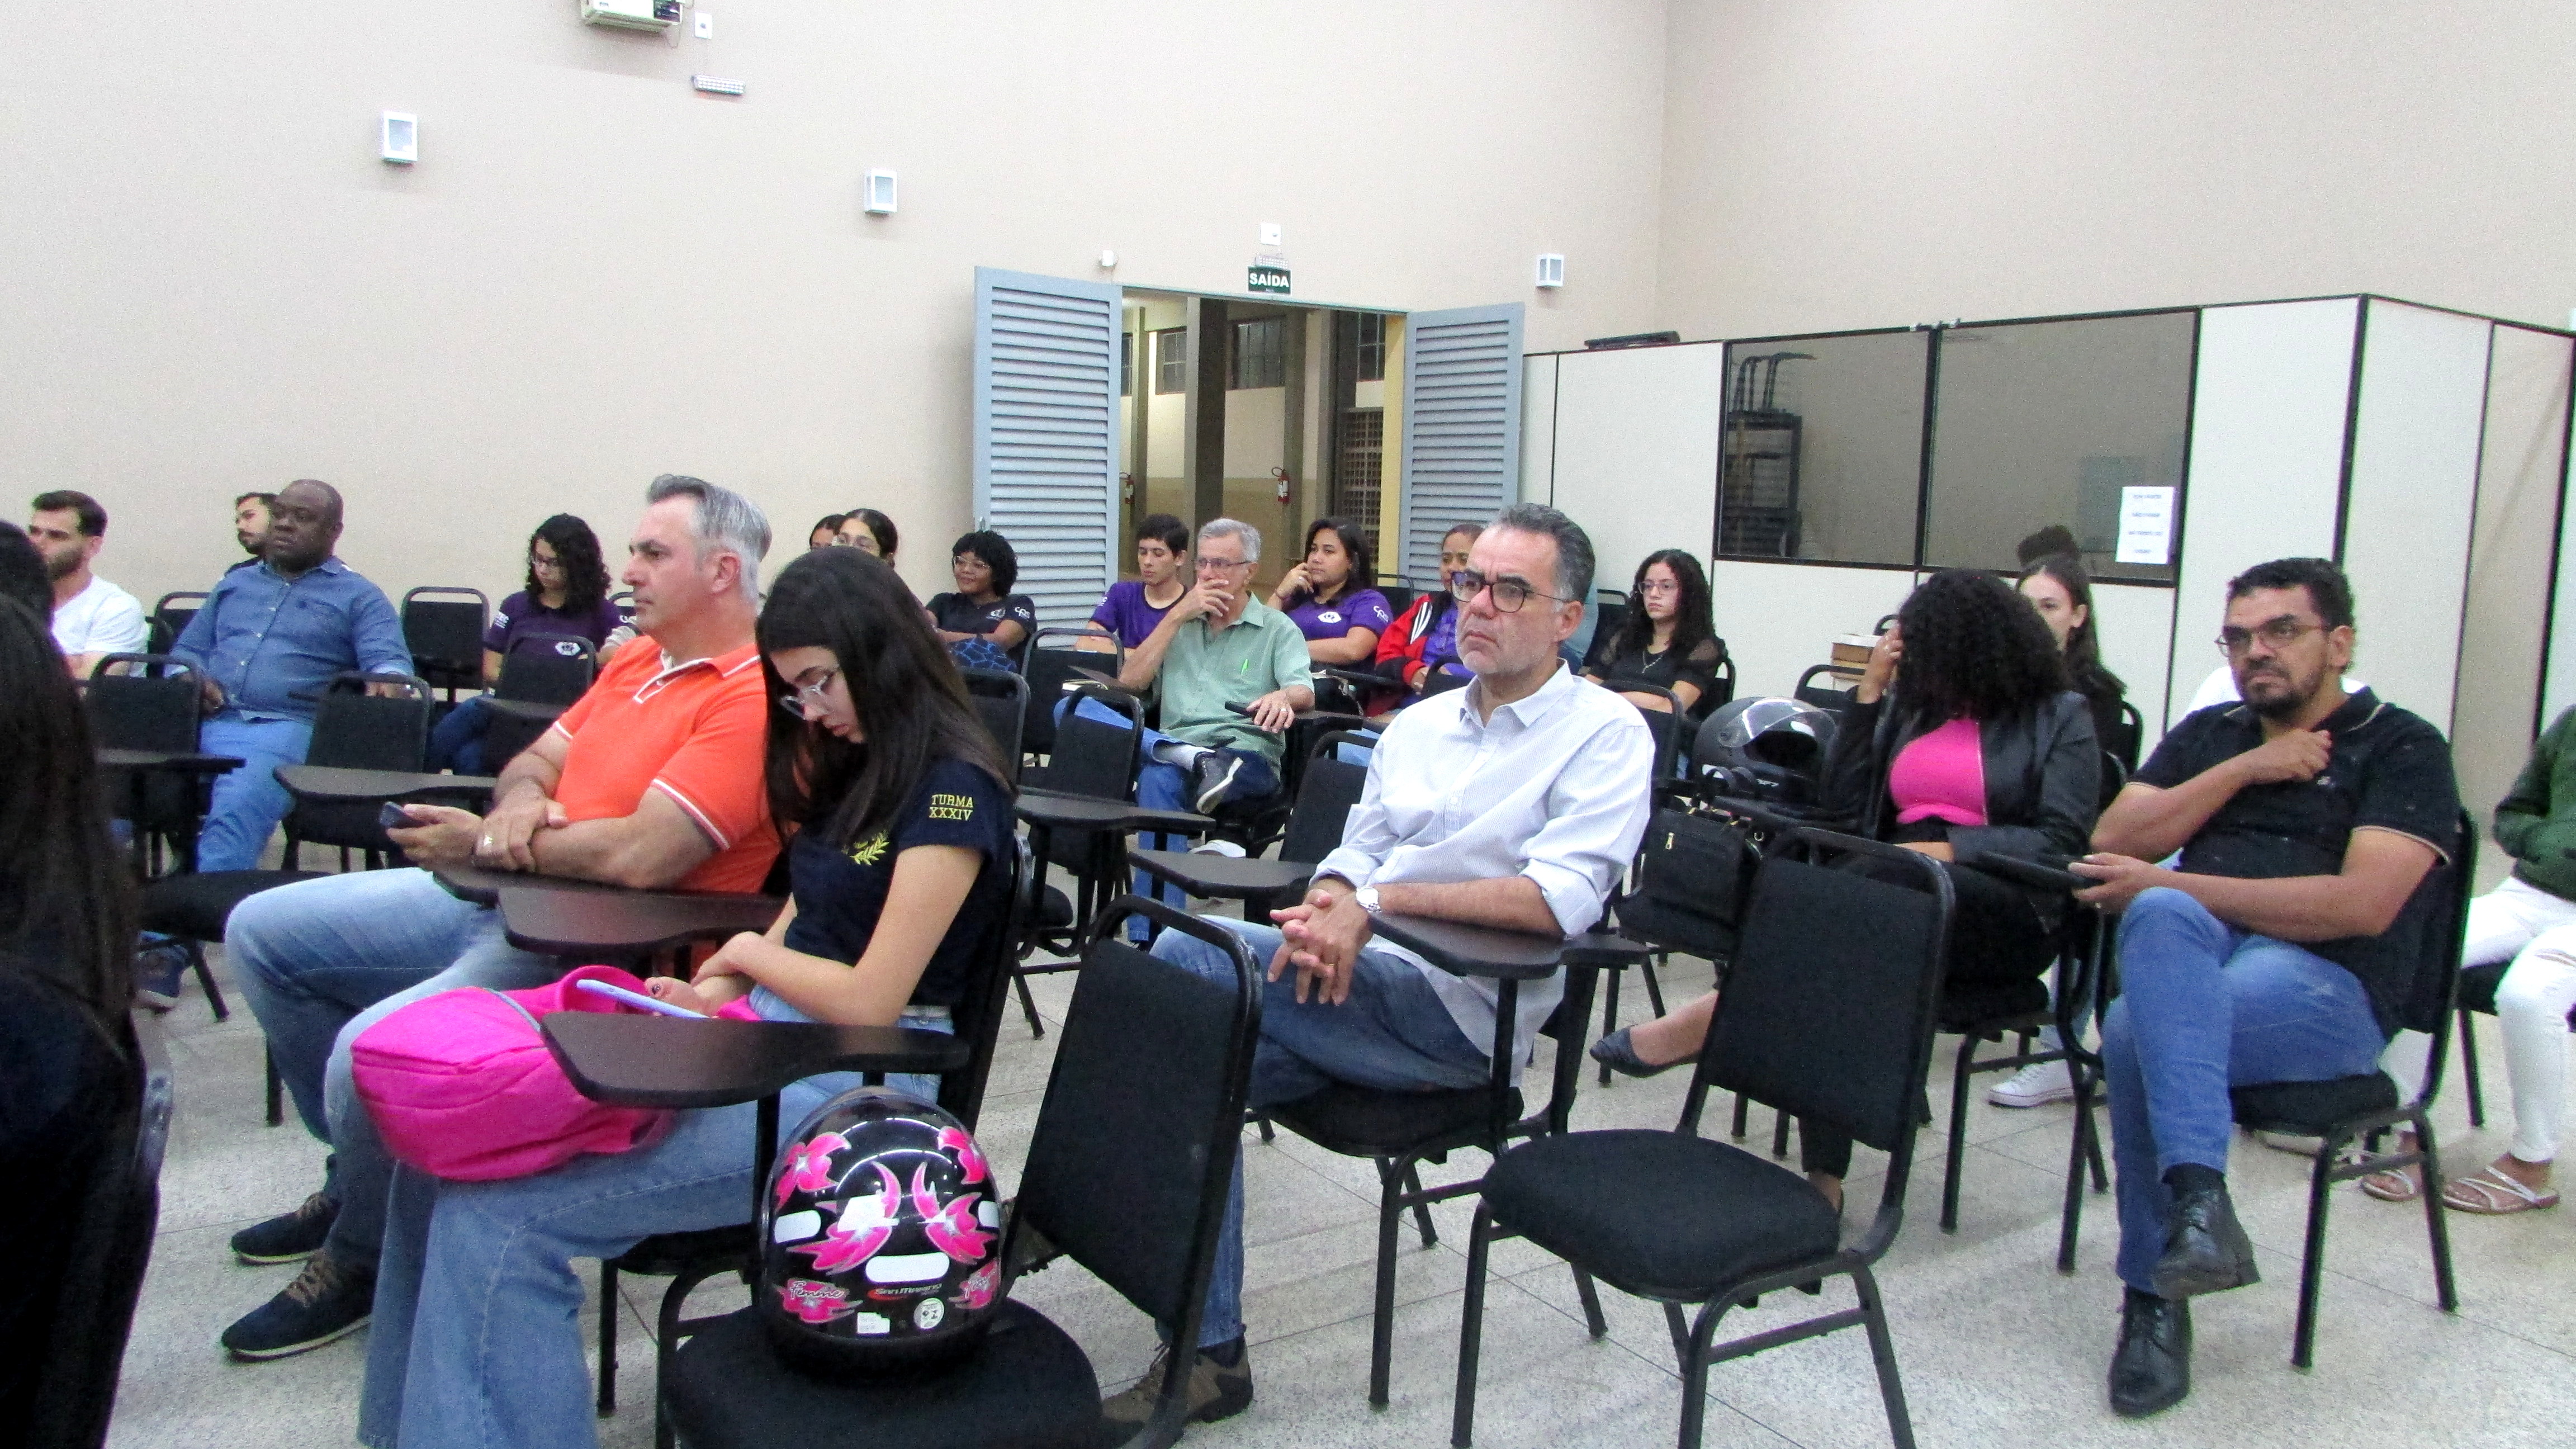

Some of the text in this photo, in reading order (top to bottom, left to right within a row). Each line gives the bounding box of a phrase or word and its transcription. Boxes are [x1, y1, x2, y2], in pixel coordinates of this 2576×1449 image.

[1249, 271, 1289, 287] SAÍDA
[931, 794, 973, 808] TURMA
[929, 807, 973, 821] XXXIV
